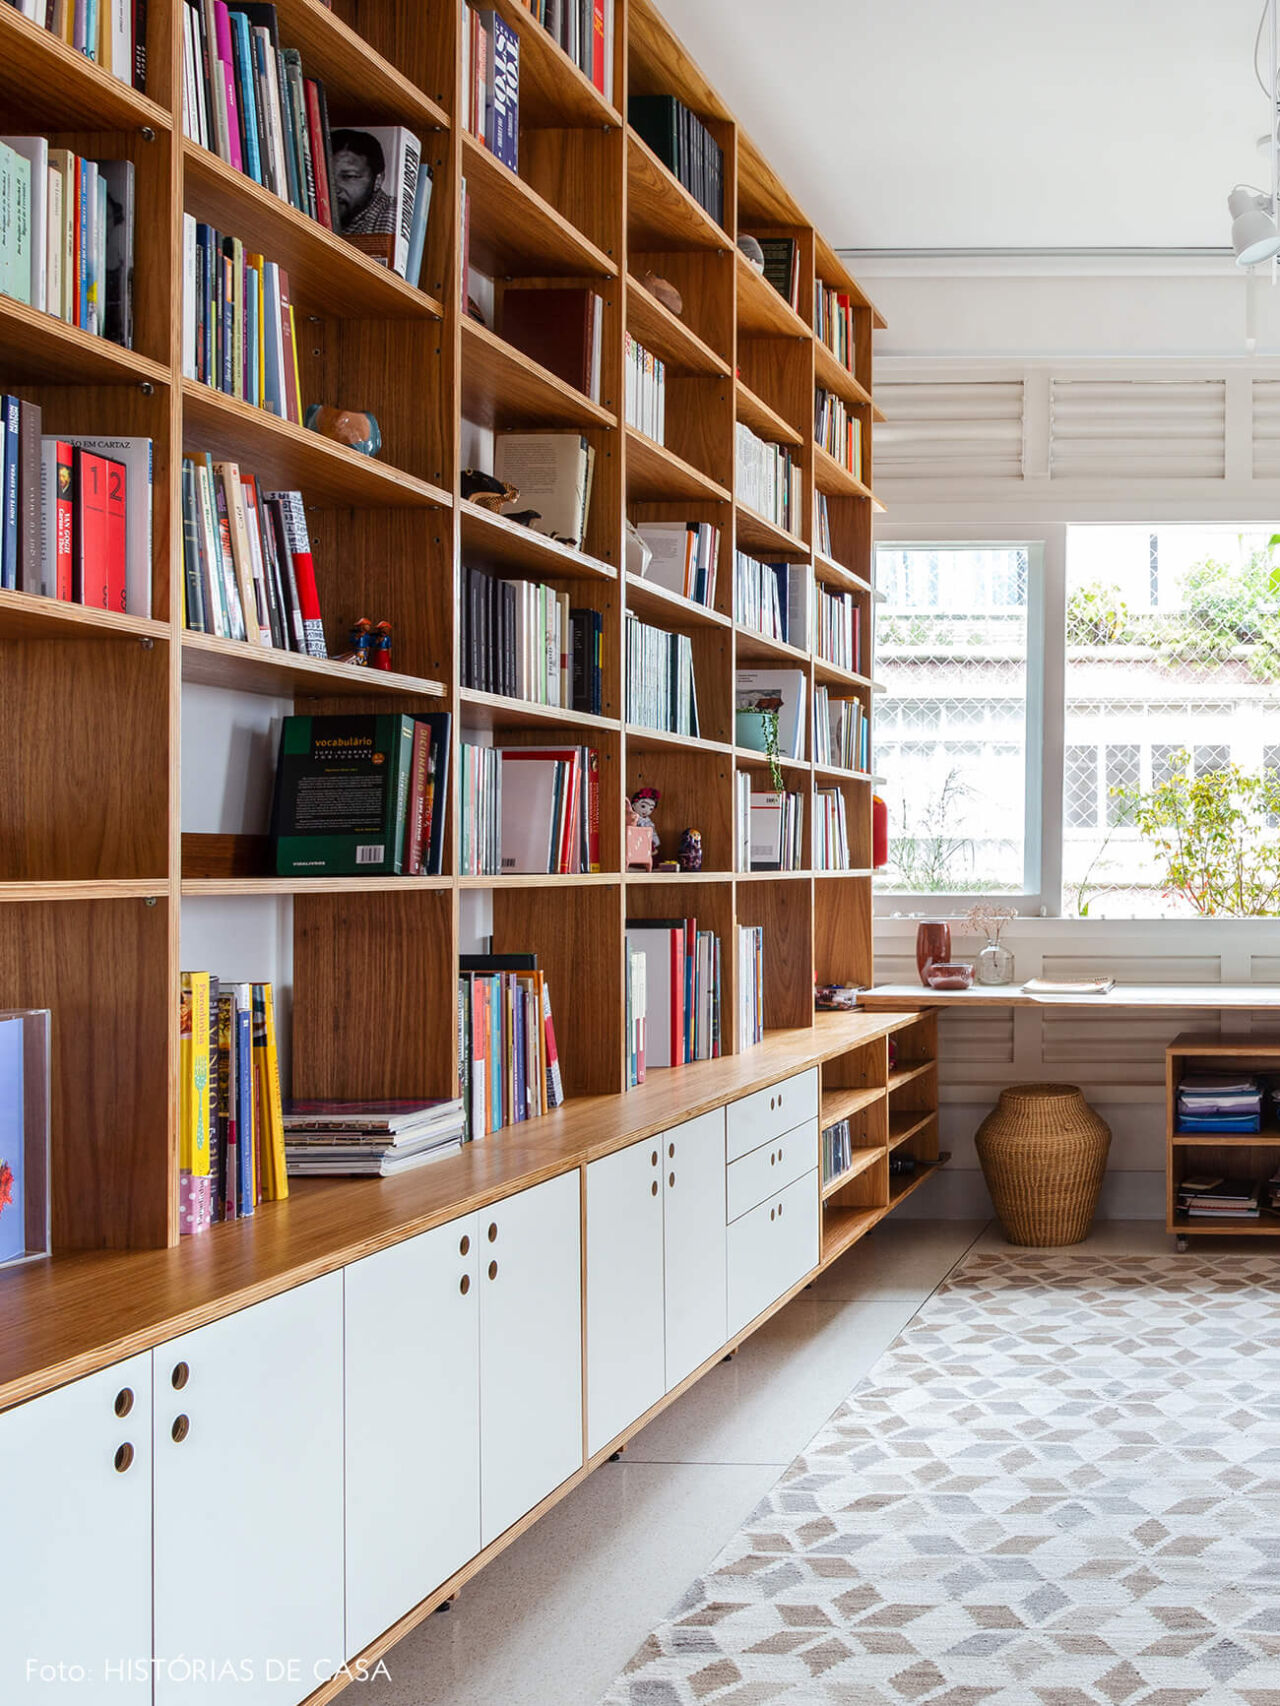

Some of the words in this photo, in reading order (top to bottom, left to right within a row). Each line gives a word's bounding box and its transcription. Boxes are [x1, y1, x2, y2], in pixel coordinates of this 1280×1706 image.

[404, 144, 419, 191] NELSON
[400, 188, 415, 242] MANDELA
[83, 440, 96, 448] EM
[97, 440, 131, 449] CARTAZ
[109, 472, 123, 501] 2
[315, 736, 373, 747] vocabulário
[198, 983, 208, 1045] Panelinha
